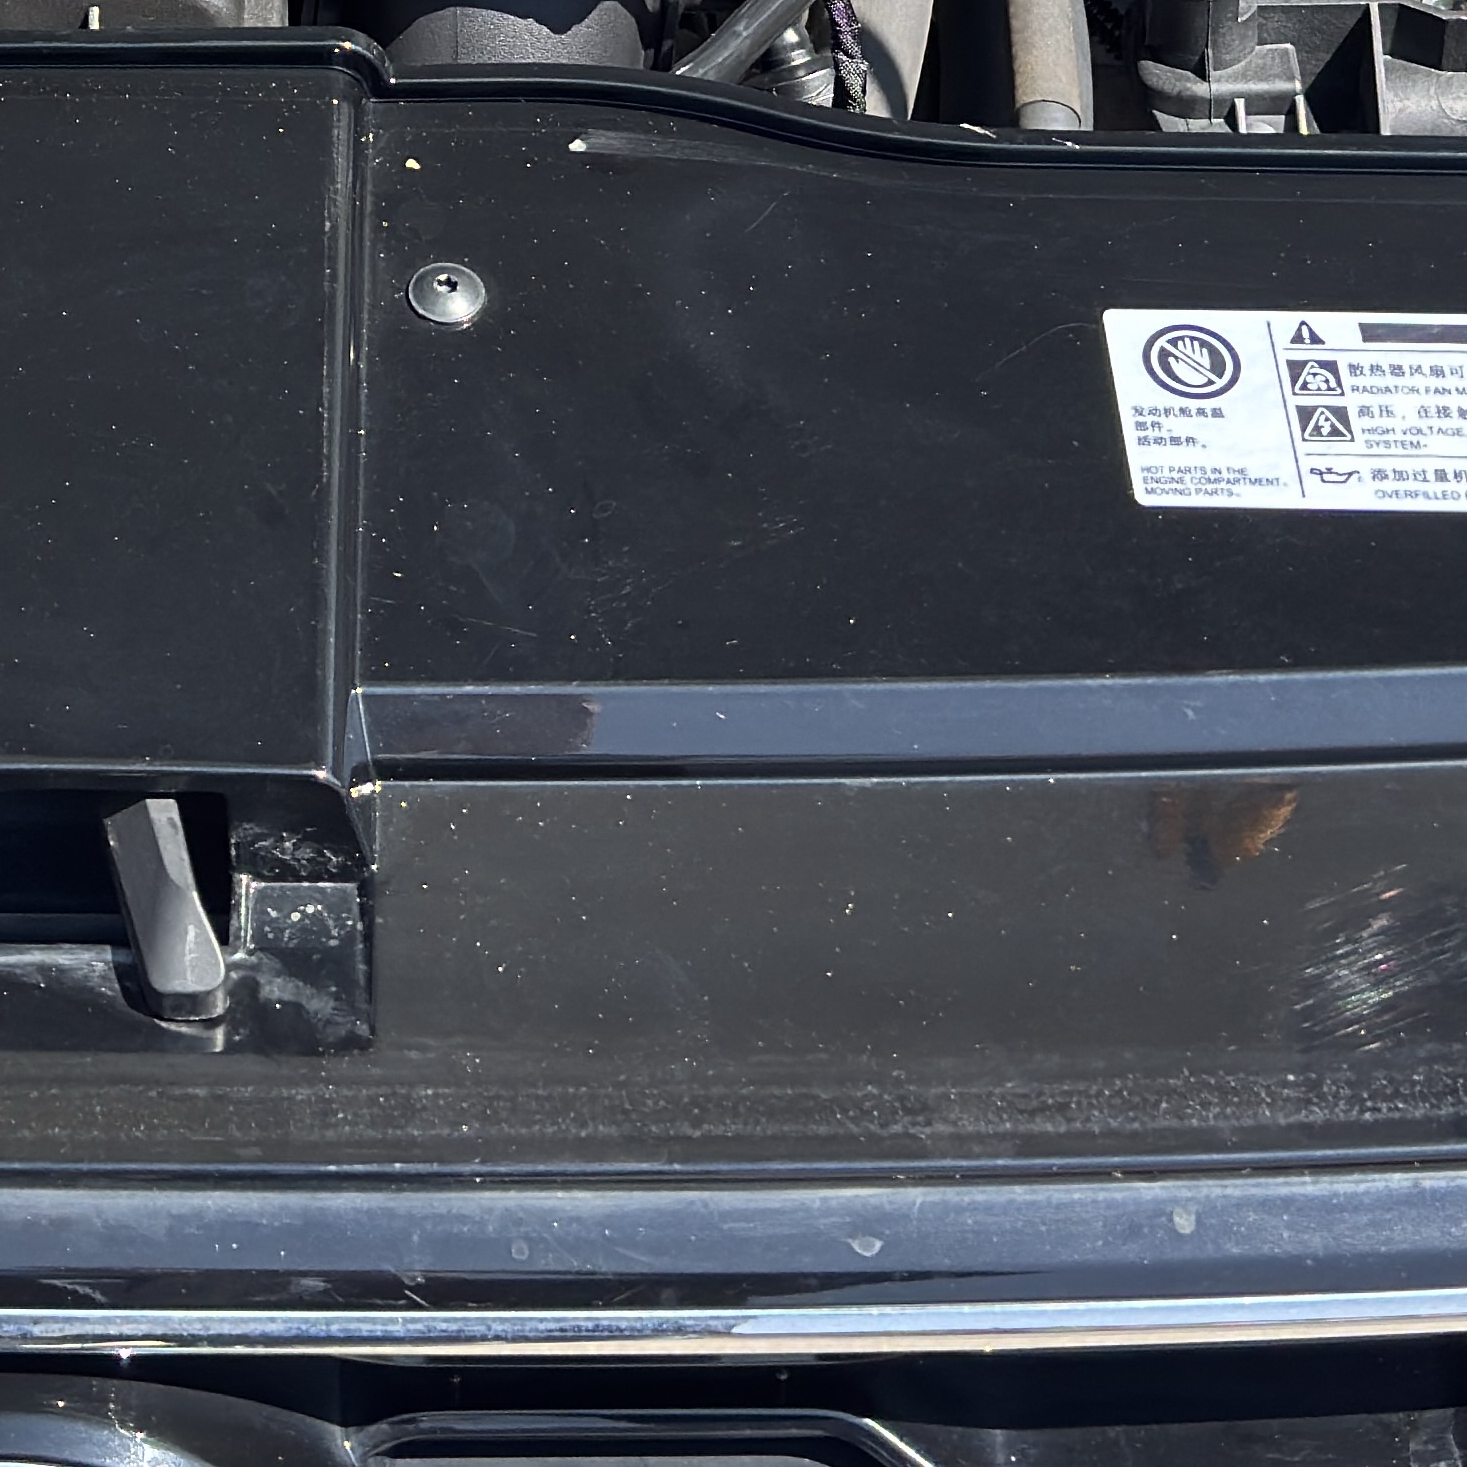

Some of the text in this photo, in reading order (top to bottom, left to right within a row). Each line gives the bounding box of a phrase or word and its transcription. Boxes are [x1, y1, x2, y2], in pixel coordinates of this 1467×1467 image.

[1351, 384, 1420, 396] RADIATOR
[1425, 385, 1452, 396] FAN
[1361, 426, 1395, 436] HIGH
[1141, 465, 1249, 476] HOT PARTS IN THE
[1143, 476, 1187, 485] ENGINE
[1145, 487, 1192, 497] MOVING
[1374, 489, 1461, 500] OVERFILLED
